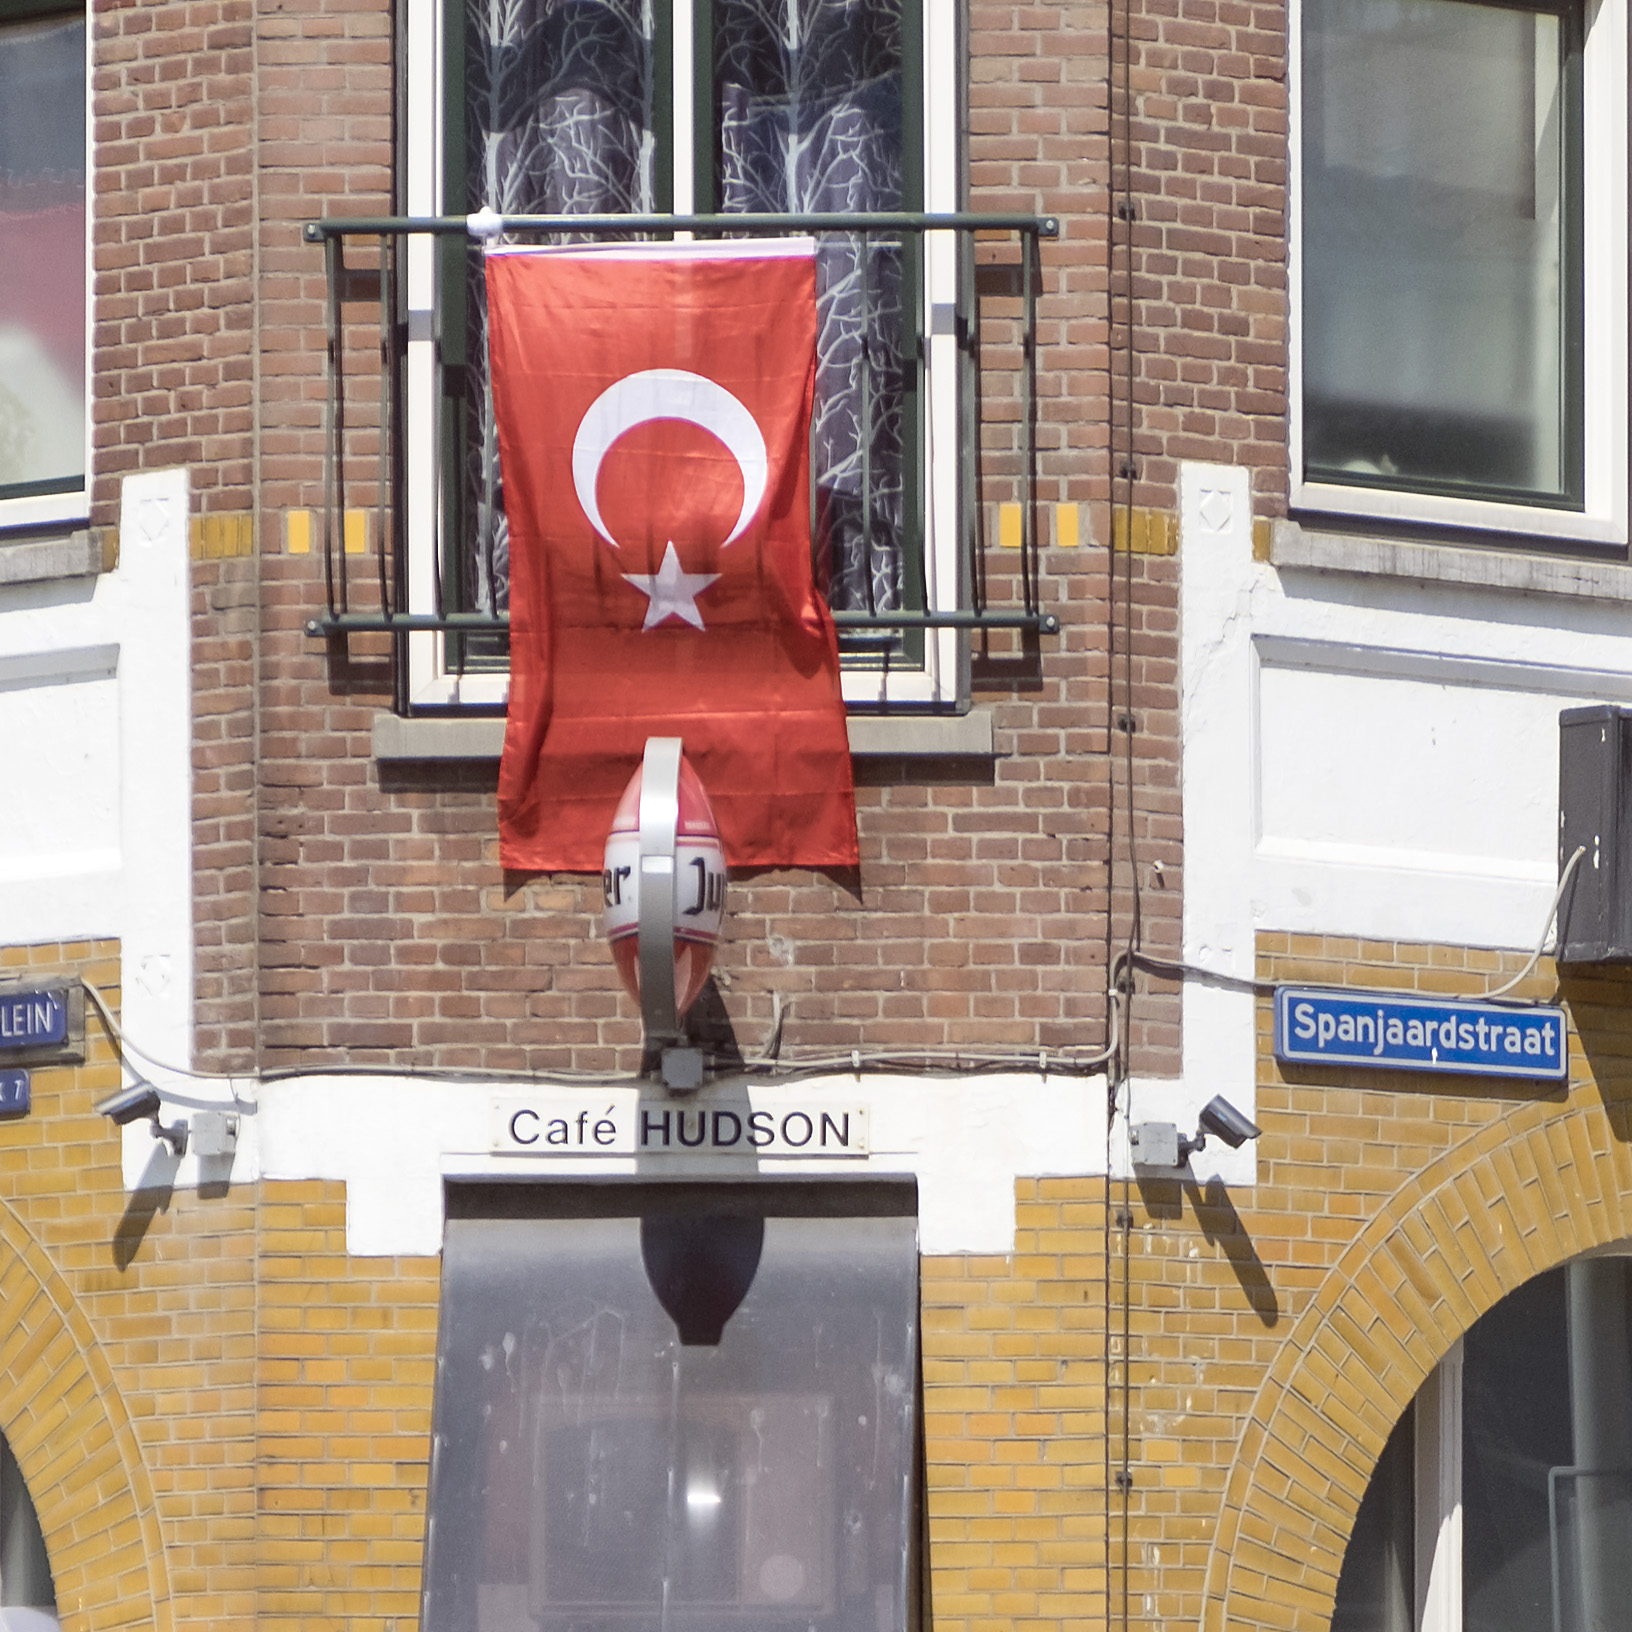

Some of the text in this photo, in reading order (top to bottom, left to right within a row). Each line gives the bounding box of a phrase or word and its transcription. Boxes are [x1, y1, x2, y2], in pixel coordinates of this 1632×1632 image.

[1294, 1003, 1556, 1056] Spanjaardstraat
[508, 1105, 850, 1147] Café HUDSON
